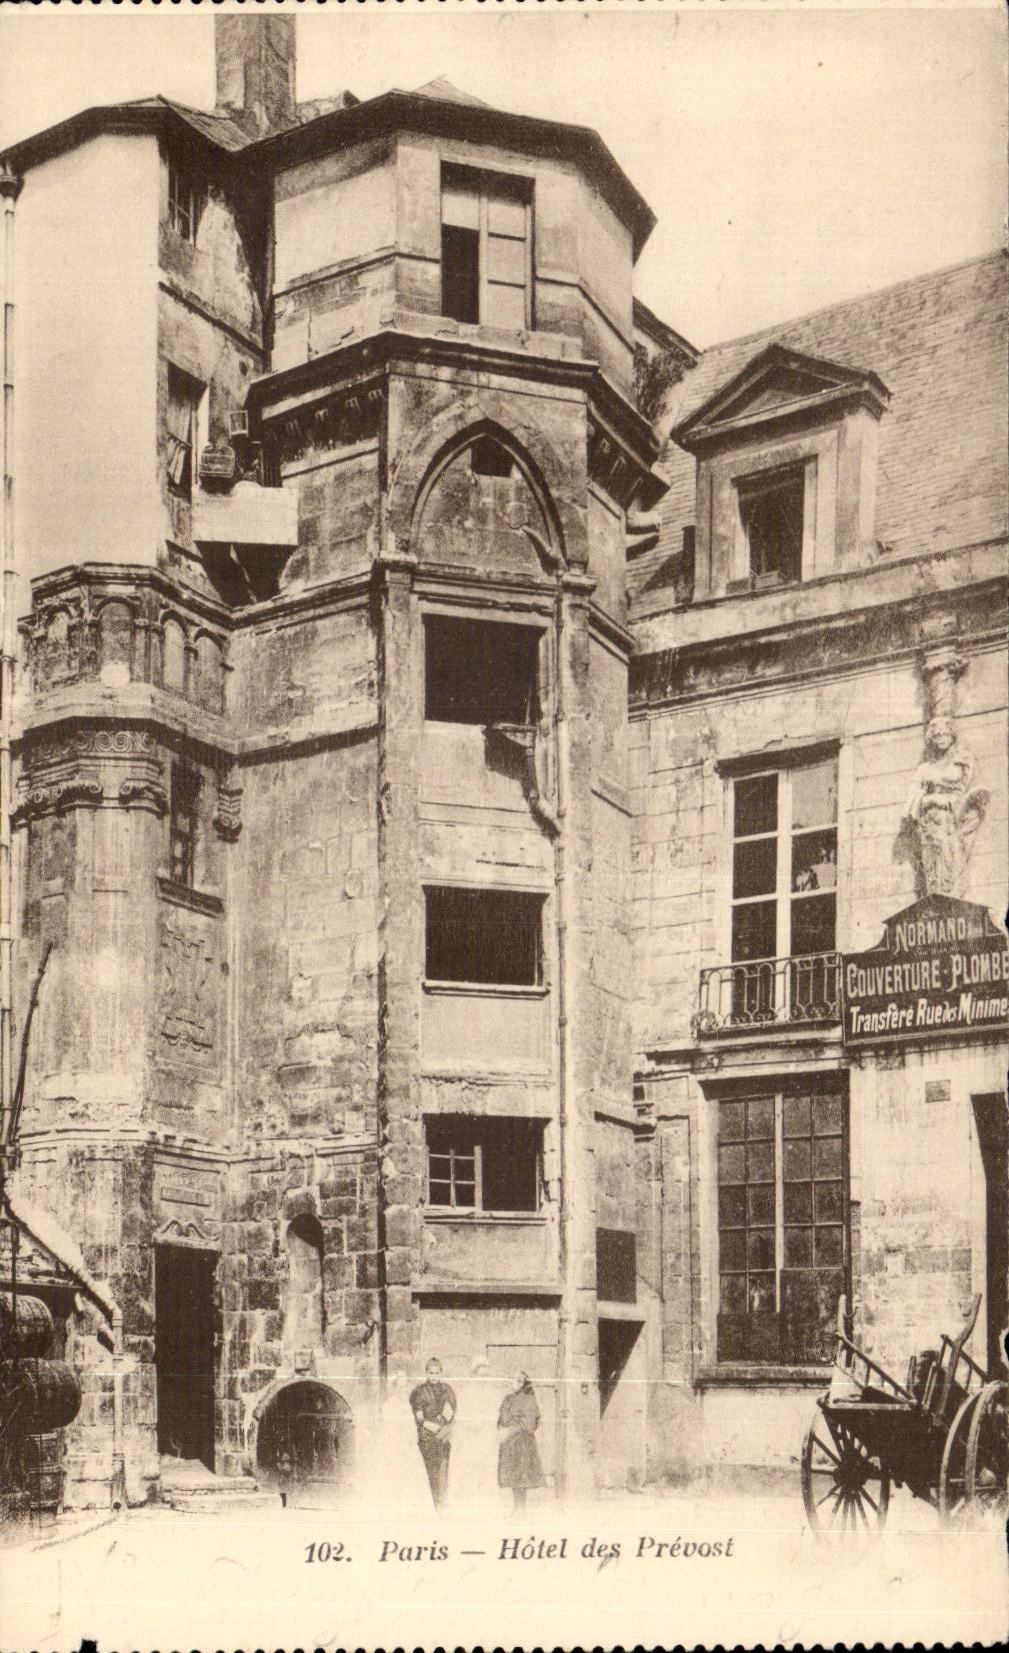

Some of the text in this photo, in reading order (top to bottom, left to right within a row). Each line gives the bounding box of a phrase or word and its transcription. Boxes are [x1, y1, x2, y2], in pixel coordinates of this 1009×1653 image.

[894, 917, 966, 955] NORMAND
[916, 998, 943, 1026] Rue
[957, 992, 1009, 1025] Minime
